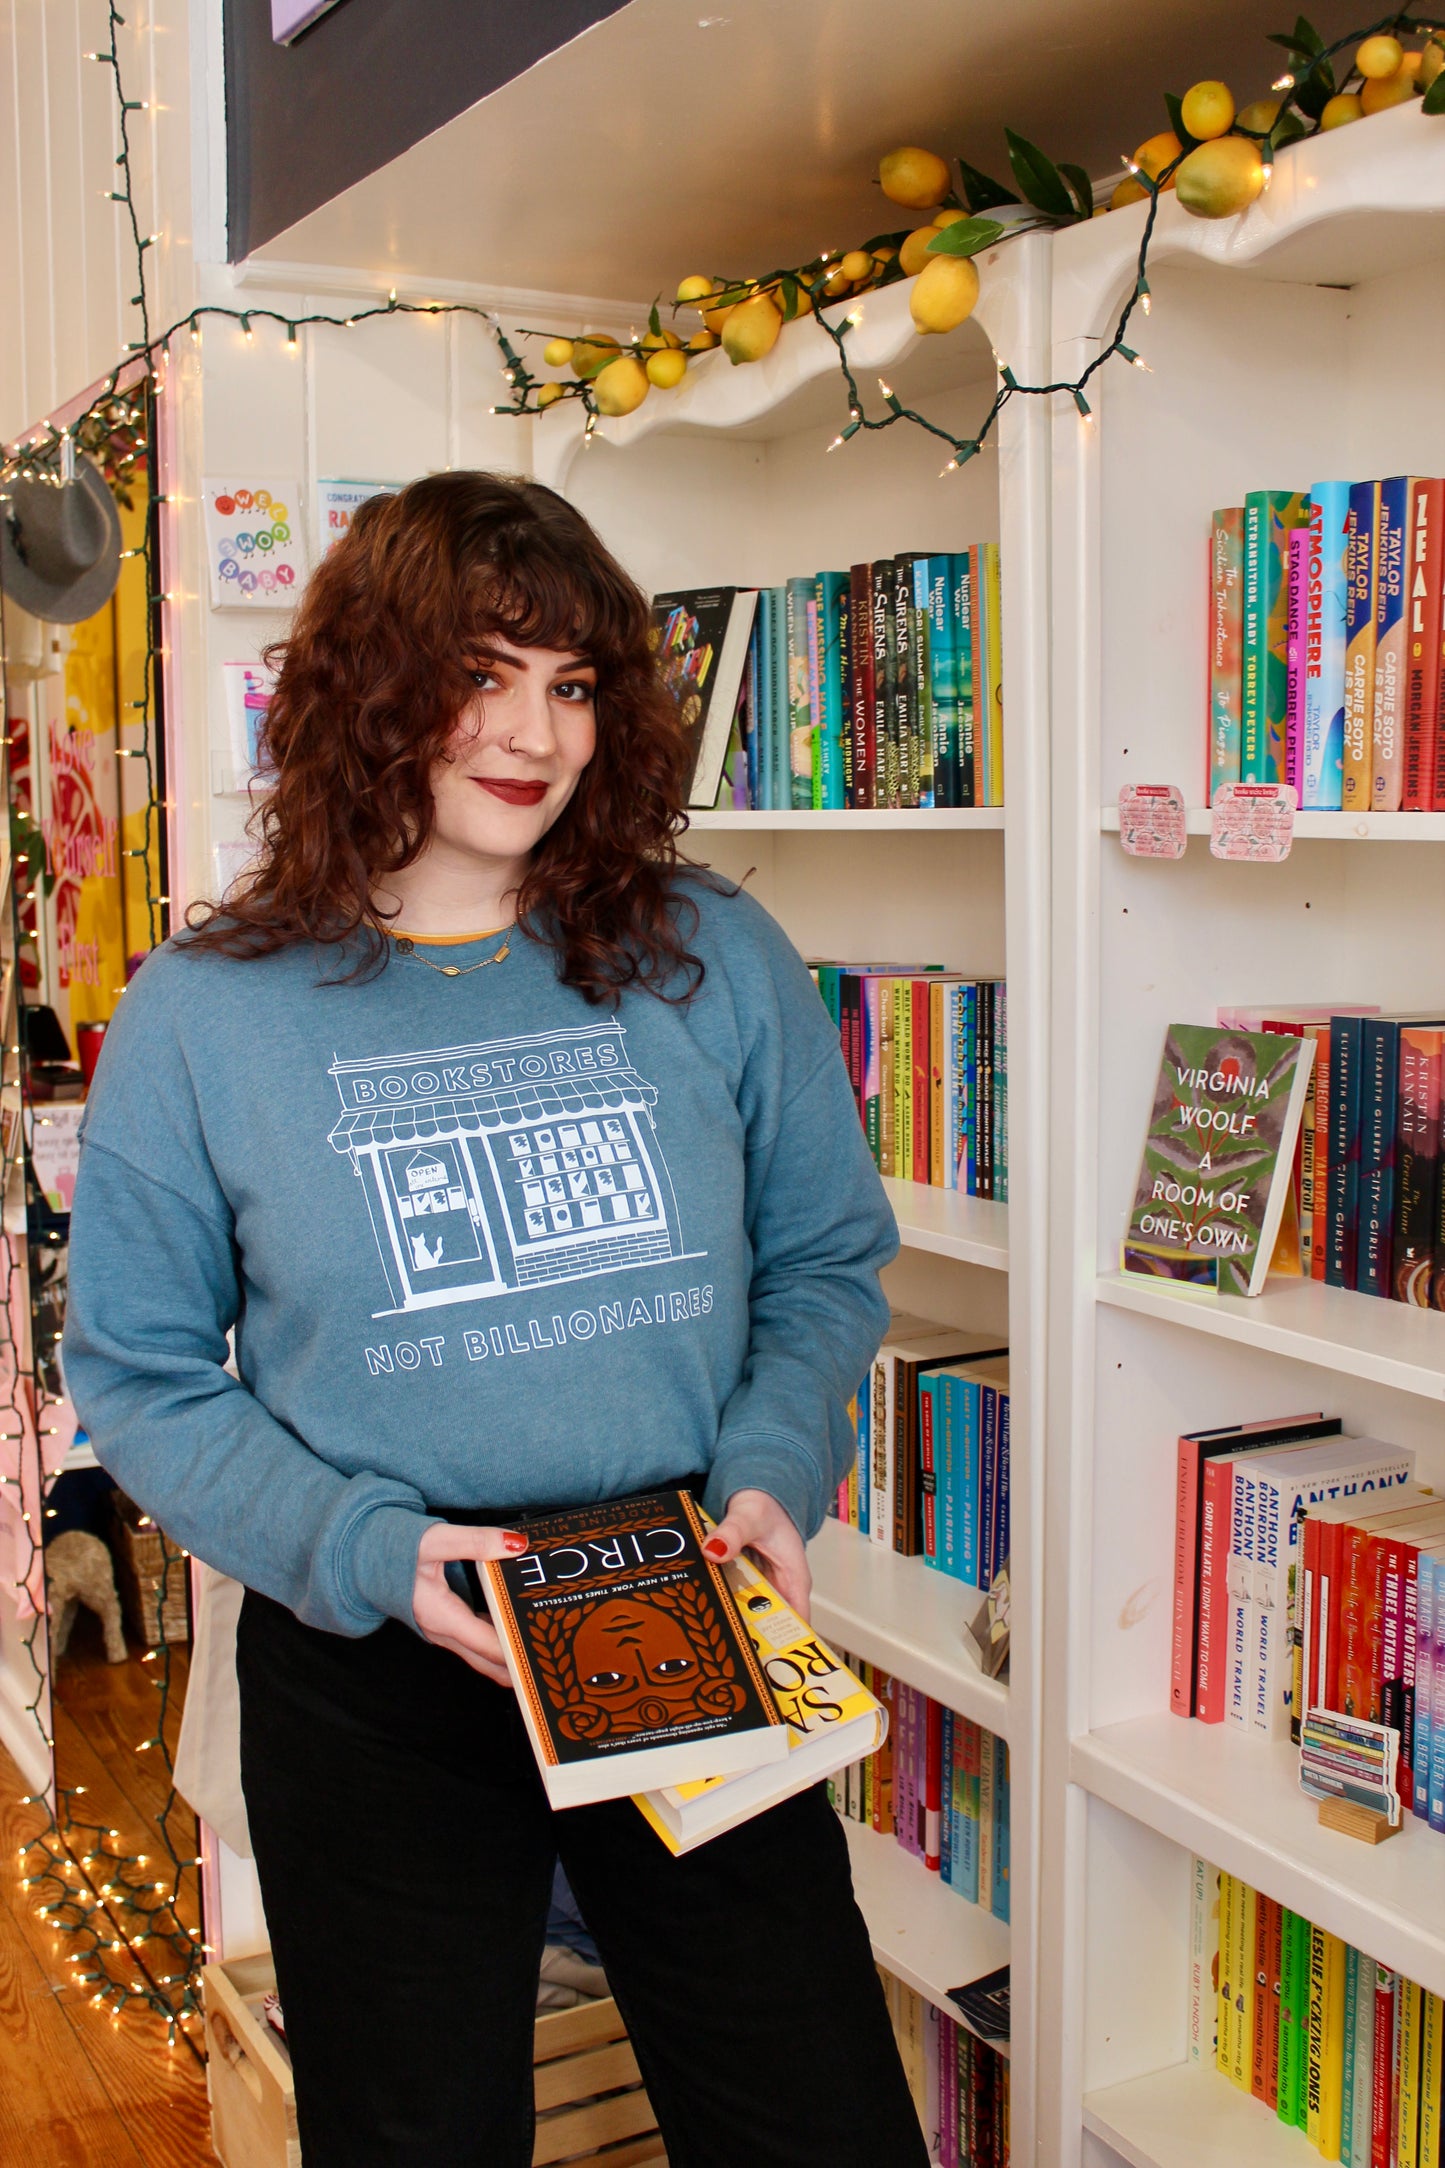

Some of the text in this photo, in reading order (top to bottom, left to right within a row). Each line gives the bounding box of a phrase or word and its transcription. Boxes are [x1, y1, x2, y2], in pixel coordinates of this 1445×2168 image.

[221, 561, 290, 589] BABY
[1247, 507, 1259, 646] DETRANSITION, BABY
[1288, 540, 1300, 640] STAG DANCE
[1306, 502, 1323, 679] ATMOSPHERE
[1346, 508, 1357, 627] JENKINS REID
[1356, 532, 1369, 600] TAYLOR
[1378, 502, 1388, 623] JENKINS REID
[1387, 527, 1402, 596] TAYLOR
[1411, 494, 1428, 633] ZEAL
[873, 574, 888, 660] THE SIRENS
[895, 567, 910, 654] THE SIRENS
[914, 570, 924, 690] KAKIGORI SUMMER
[935, 576, 946, 632] Nuclear
[960, 574, 971, 630] Nuclear
[1216, 528, 1228, 667] Sicilian Inheritance
[858, 600, 869, 666] KRISTIN
[932, 700, 940, 767] Jacobsen
[938, 713, 948, 754] Annie
[957, 700, 965, 768] Jacobsen
[964, 712, 974, 754] Annie
[1246, 655, 1256, 761] TORREY PETERS
[1288, 668, 1298, 733] TORREY
[1311, 705, 1320, 750] TAYLOR
[1344, 670, 1352, 746] IS BACK
[1352, 654, 1365, 761] CARRIE SOTO
[1374, 668, 1384, 745] IS BACK
[1382, 651, 1397, 759] CARRIE SOTO
[1407, 669, 1423, 798] MORGAN JERKINS
[50, 719, 96, 776] Love
[856, 700, 866, 772] WOMEN
[876, 700, 885, 780] EMILIA HART
[896, 694, 908, 775] EMILIA HART
[39, 816, 118, 878] Yourself
[60, 923, 100, 988] First
[352, 1043, 620, 1104] BOOKSTORES
[881, 1040, 889, 1051] 19
[905, 1075, 910, 1086] DO
[1176, 1066, 1270, 1099] VIRGINIA
[1316, 1062, 1330, 1133] HOMEGOING
[1339, 1032, 1348, 1156] ELIZABETH GILBERT
[1372, 1036, 1384, 1161] ELIZABETH GILBERT
[1403, 1055, 1415, 1134] HANNAH
[1417, 1056, 1429, 1135] KRISTIN
[1179, 1105, 1256, 1135] WOOLF
[411, 1166, 438, 1177] OPEN
[1198, 1151, 1212, 1171] A
[1302, 1128, 1315, 1212] lauren groff
[1314, 1155, 1328, 1217] YAA GYASI
[1336, 1163, 1346, 1194] CITY
[1371, 1169, 1380, 1202] CITY
[1152, 1180, 1250, 1214] ROOM OF
[1139, 1215, 1248, 1254] ONE'S OWN
[1335, 1212, 1344, 1252] GIRLS
[1368, 1219, 1378, 1259] GIRLS
[365, 1285, 714, 1375] NOT BILLIONAIRES
[522, 1505, 665, 1537] MADELINE MILL
[963, 1502, 971, 1560] PAIRING
[1204, 1500, 1214, 1533] SORRY
[1204, 1535, 1214, 1552] I'M
[1232, 1475, 1245, 1556] BOURDAIN
[1243, 1479, 1254, 1561] ANTHONY
[1257, 1481, 1268, 1563] BOURDAIN
[1267, 1486, 1279, 1568] ANTHONY
[515, 1528, 687, 1587] CIRCE
[532, 1572, 689, 1608] THE #1 NEW YORK TIMES BESTSELLER
[1202, 1553, 1213, 1578] LATE,
[1201, 1586, 1211, 1619] DIDN'T
[1201, 1620, 1210, 1647] WANT
[1383, 1553, 1398, 1680] THE THREE MOTHERS
[1402, 1560, 1417, 1686] THE THREE MOTHERS
[1419, 1569, 1432, 1636] BIG MAGIC
[1199, 1664, 1209, 1691] COME
[1200, 1649, 1210, 1663] TO
[1233, 1606, 1245, 1707] WORLD TRAVEL
[1257, 1615, 1269, 1715] WORLD TRAVEL
[1416, 1650, 1430, 1776] ELIZABETH GILBERT
[1312, 1927, 1324, 1979] LESLIE
[1308, 2057, 1320, 2113] JONES
